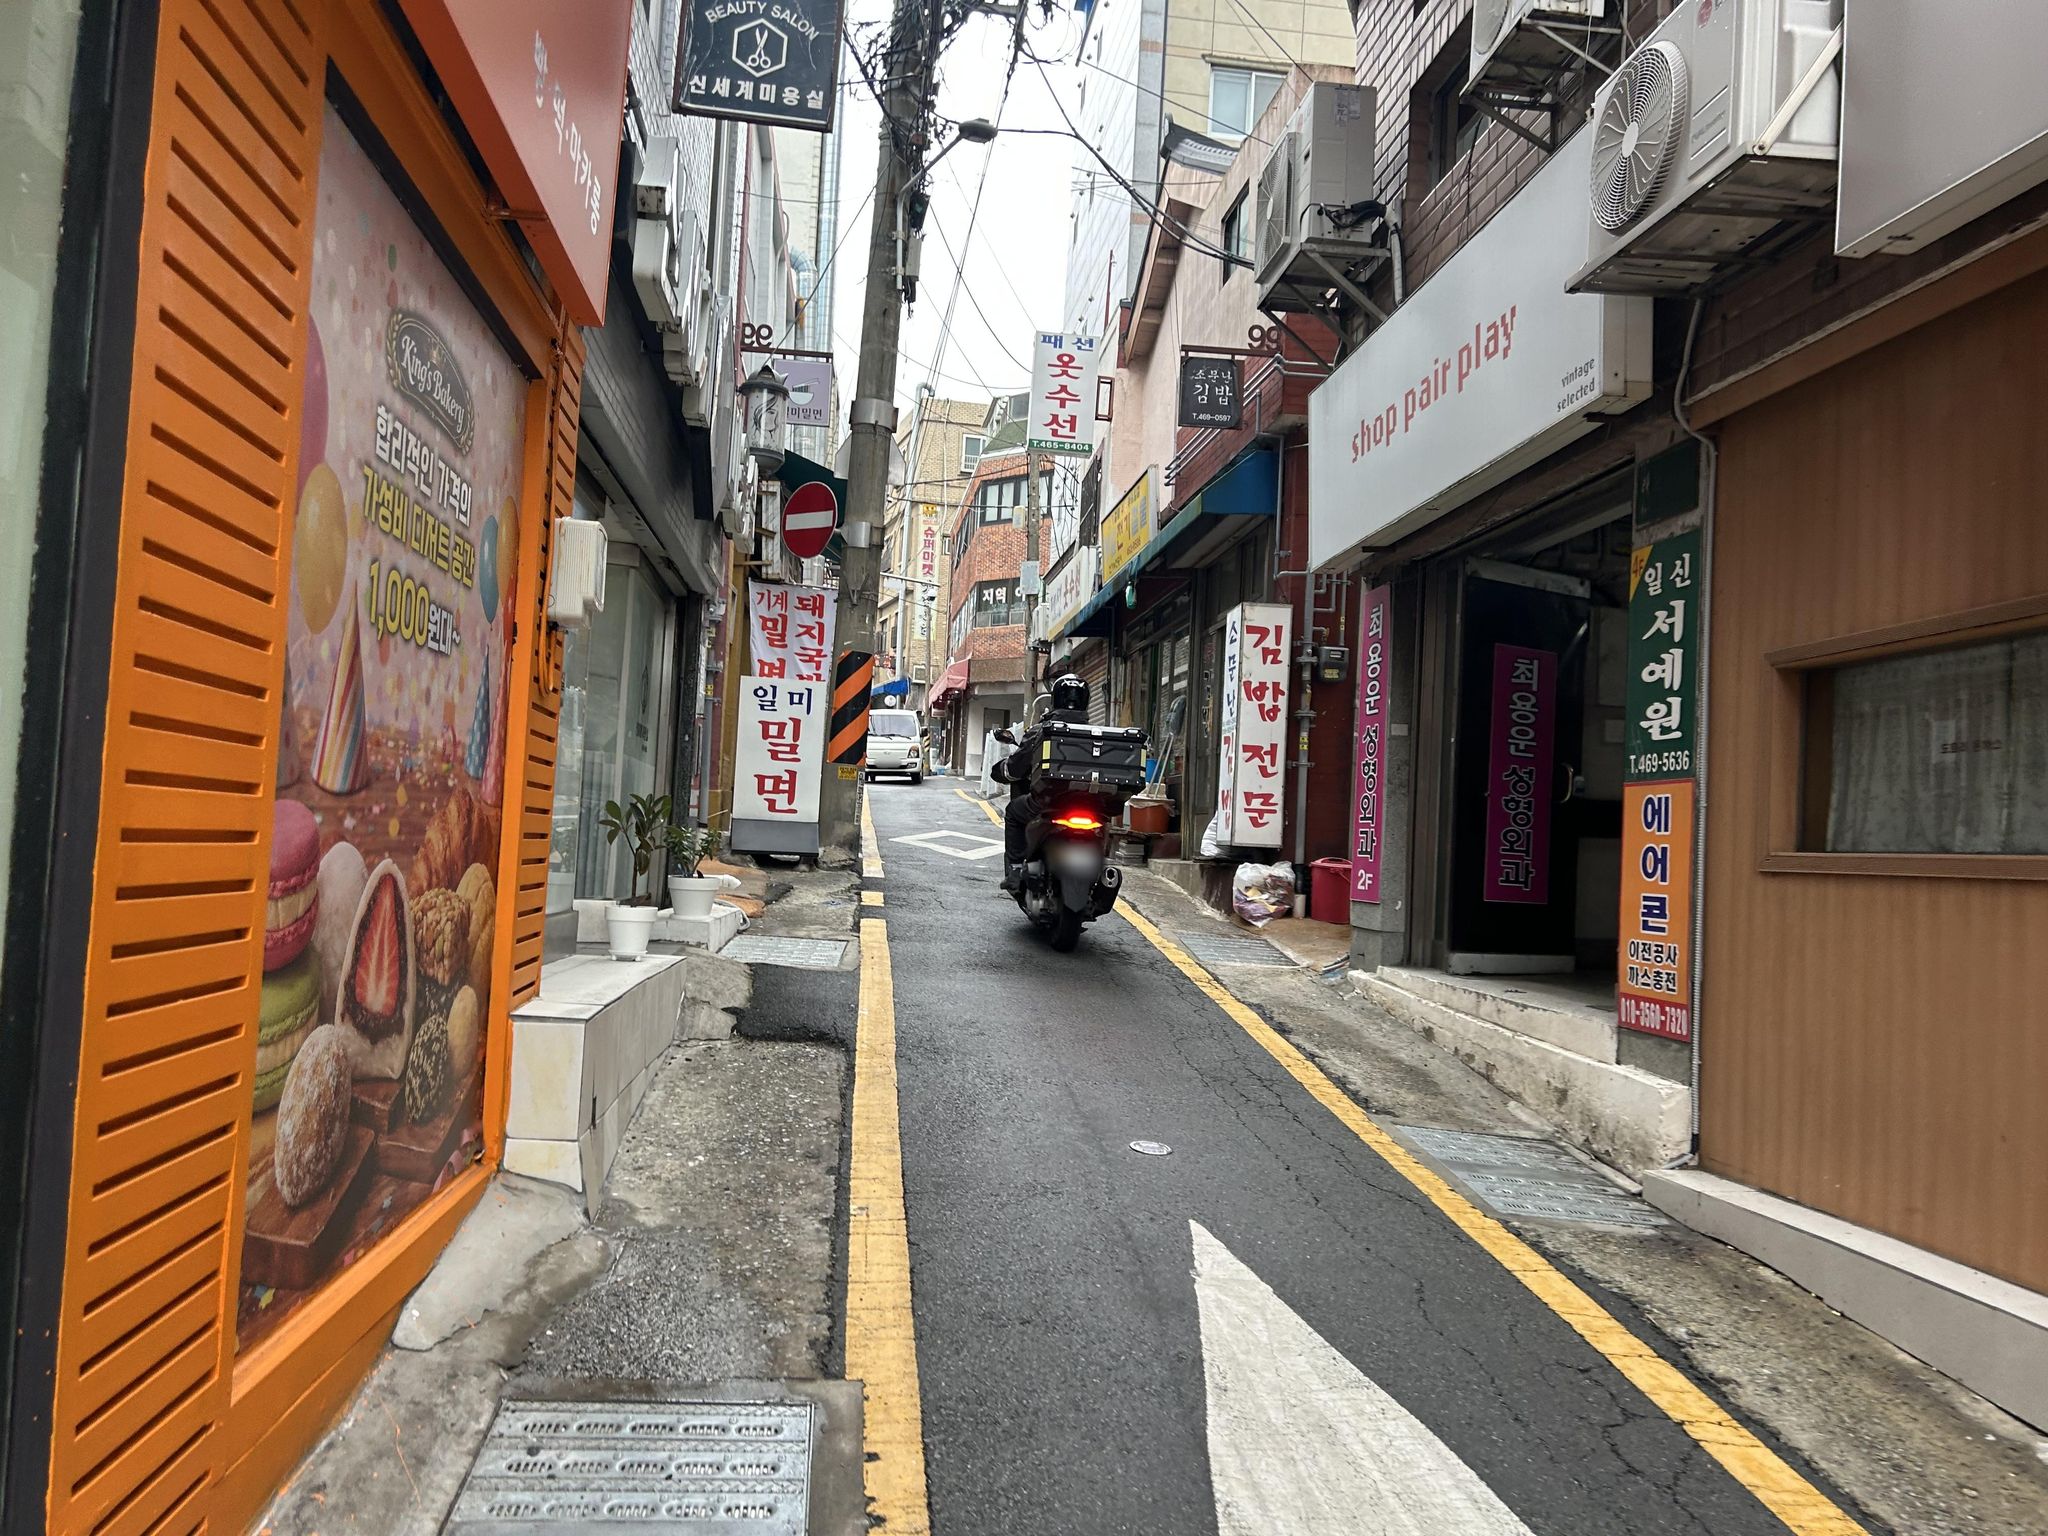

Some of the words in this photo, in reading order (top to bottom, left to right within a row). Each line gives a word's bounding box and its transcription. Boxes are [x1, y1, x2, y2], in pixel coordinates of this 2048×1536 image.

[705, 1, 767, 23] BEAUTY
[771, 5, 819, 41] SALON
[689, 75, 824, 109] 신세계미용실
[1041, 335, 1094, 352] 패션
[401, 334, 433, 388] King's
[432, 371, 464, 434] Bakery
[1191, 369, 1233, 383] 소문난
[1352, 403, 1397, 463] shop
[1404, 357, 1451, 433] pair
[1458, 305, 1517, 393] play
[1561, 358, 1595, 388] vintage
[1043, 353, 1084, 439] 옷수선
[1193, 383, 1233, 406] 김밥
[1557, 377, 1596, 413] selected
[1032, 440, 1090, 451] T.465-8404
[375, 403, 433, 498] 합리적인
[437, 461, 473, 529] 가격의
[361, 465, 408, 545] 가성비
[411, 499, 450, 573] 디저트
[451, 533, 475, 589] 공간
[1644, 553, 1692, 597] 일신
[757, 589, 788, 613] 기계
[794, 594, 828, 682] 돼지국
[1365, 603, 1384, 716] 최용운
[1639, 599, 1686, 742] 서예원
[753, 685, 813, 716] 일미
[753, 717, 802, 815] 밀면
[1629, 750, 1690, 774] T.469-5636
[1357, 723, 1379, 862] 성형외과
[1497, 763, 1537, 892] 성형외과
[1357, 869, 1374, 891] 2F
[1640, 793, 1673, 936] 에어콘
[1627, 939, 1679, 967] 이전공사
[1627, 965, 1678, 995] 까스충전
